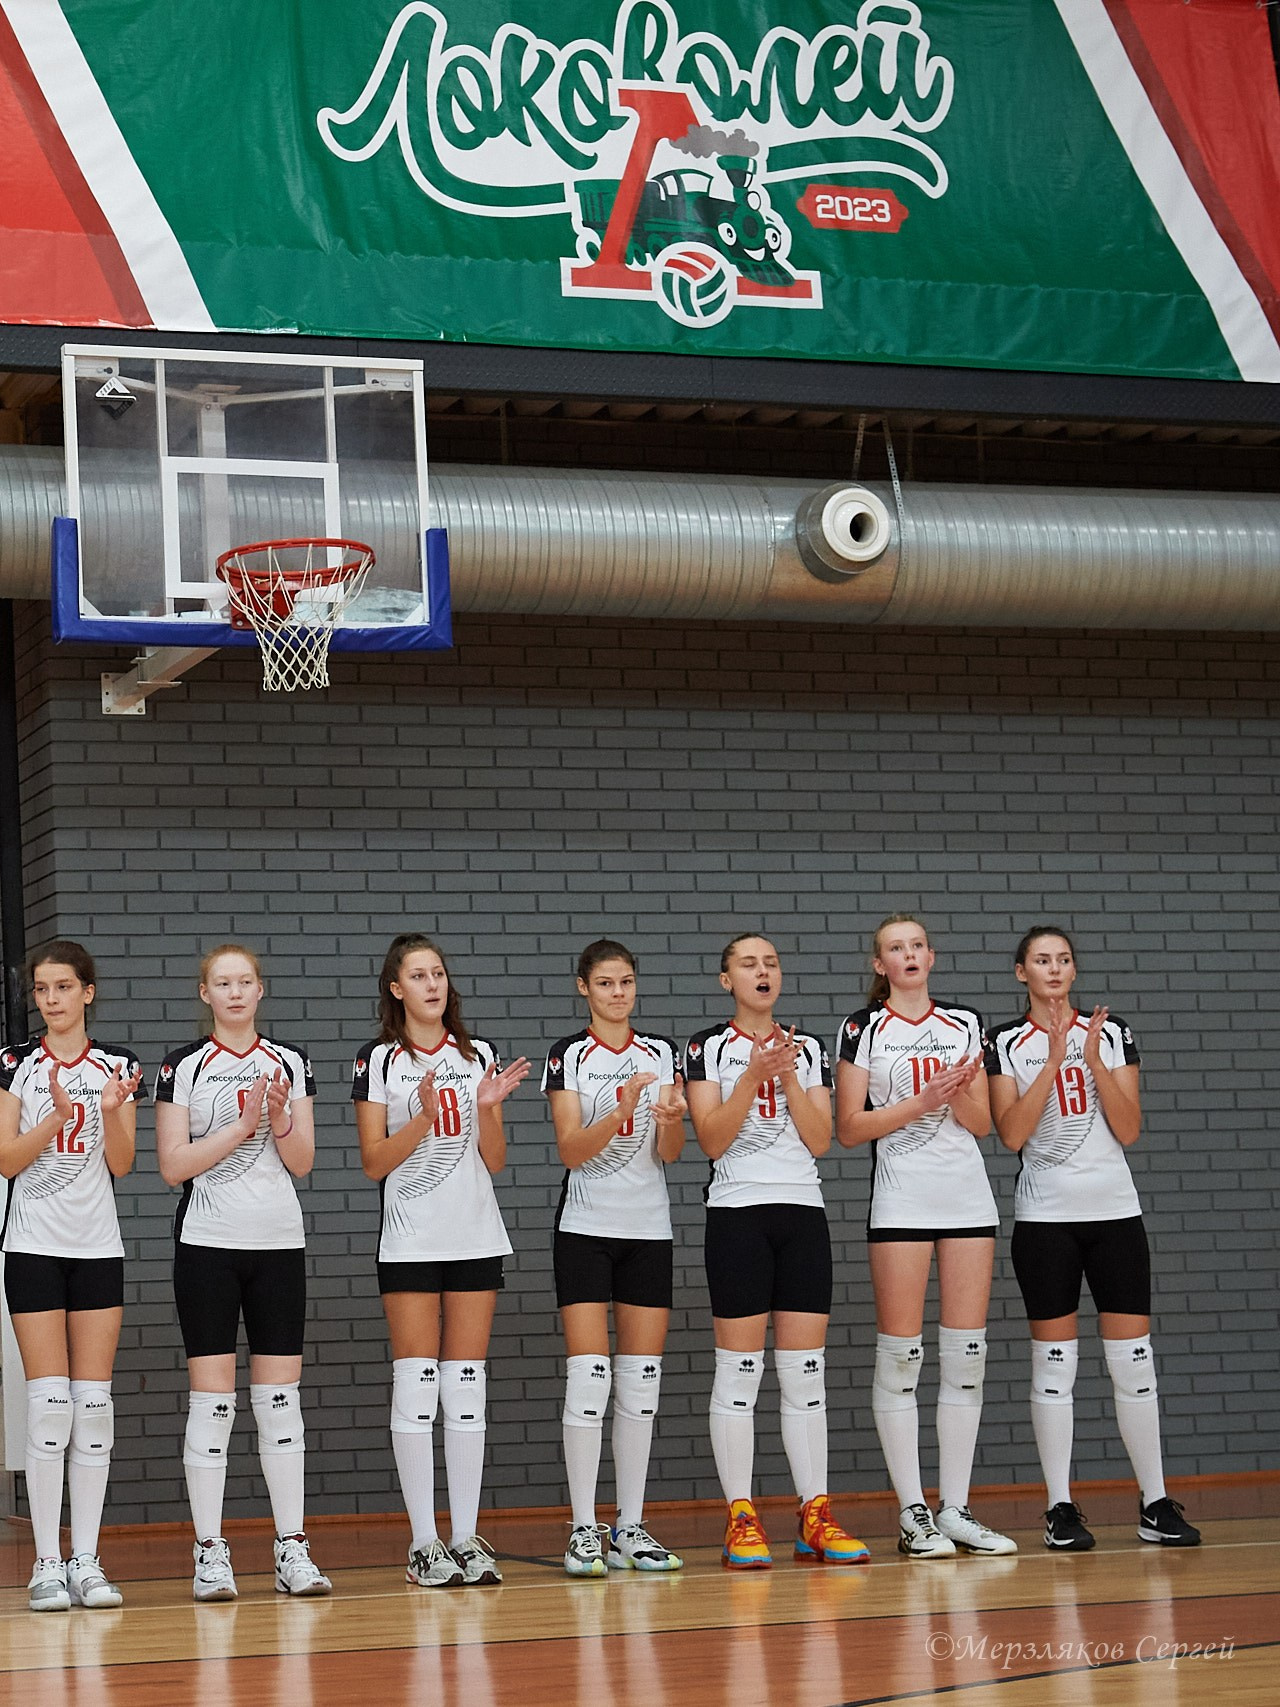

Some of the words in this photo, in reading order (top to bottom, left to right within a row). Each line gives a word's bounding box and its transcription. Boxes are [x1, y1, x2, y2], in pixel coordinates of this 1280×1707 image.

[815, 194, 891, 223] 2023
[757, 1078, 777, 1119] 9
[1054, 1066, 1087, 1117] 13
